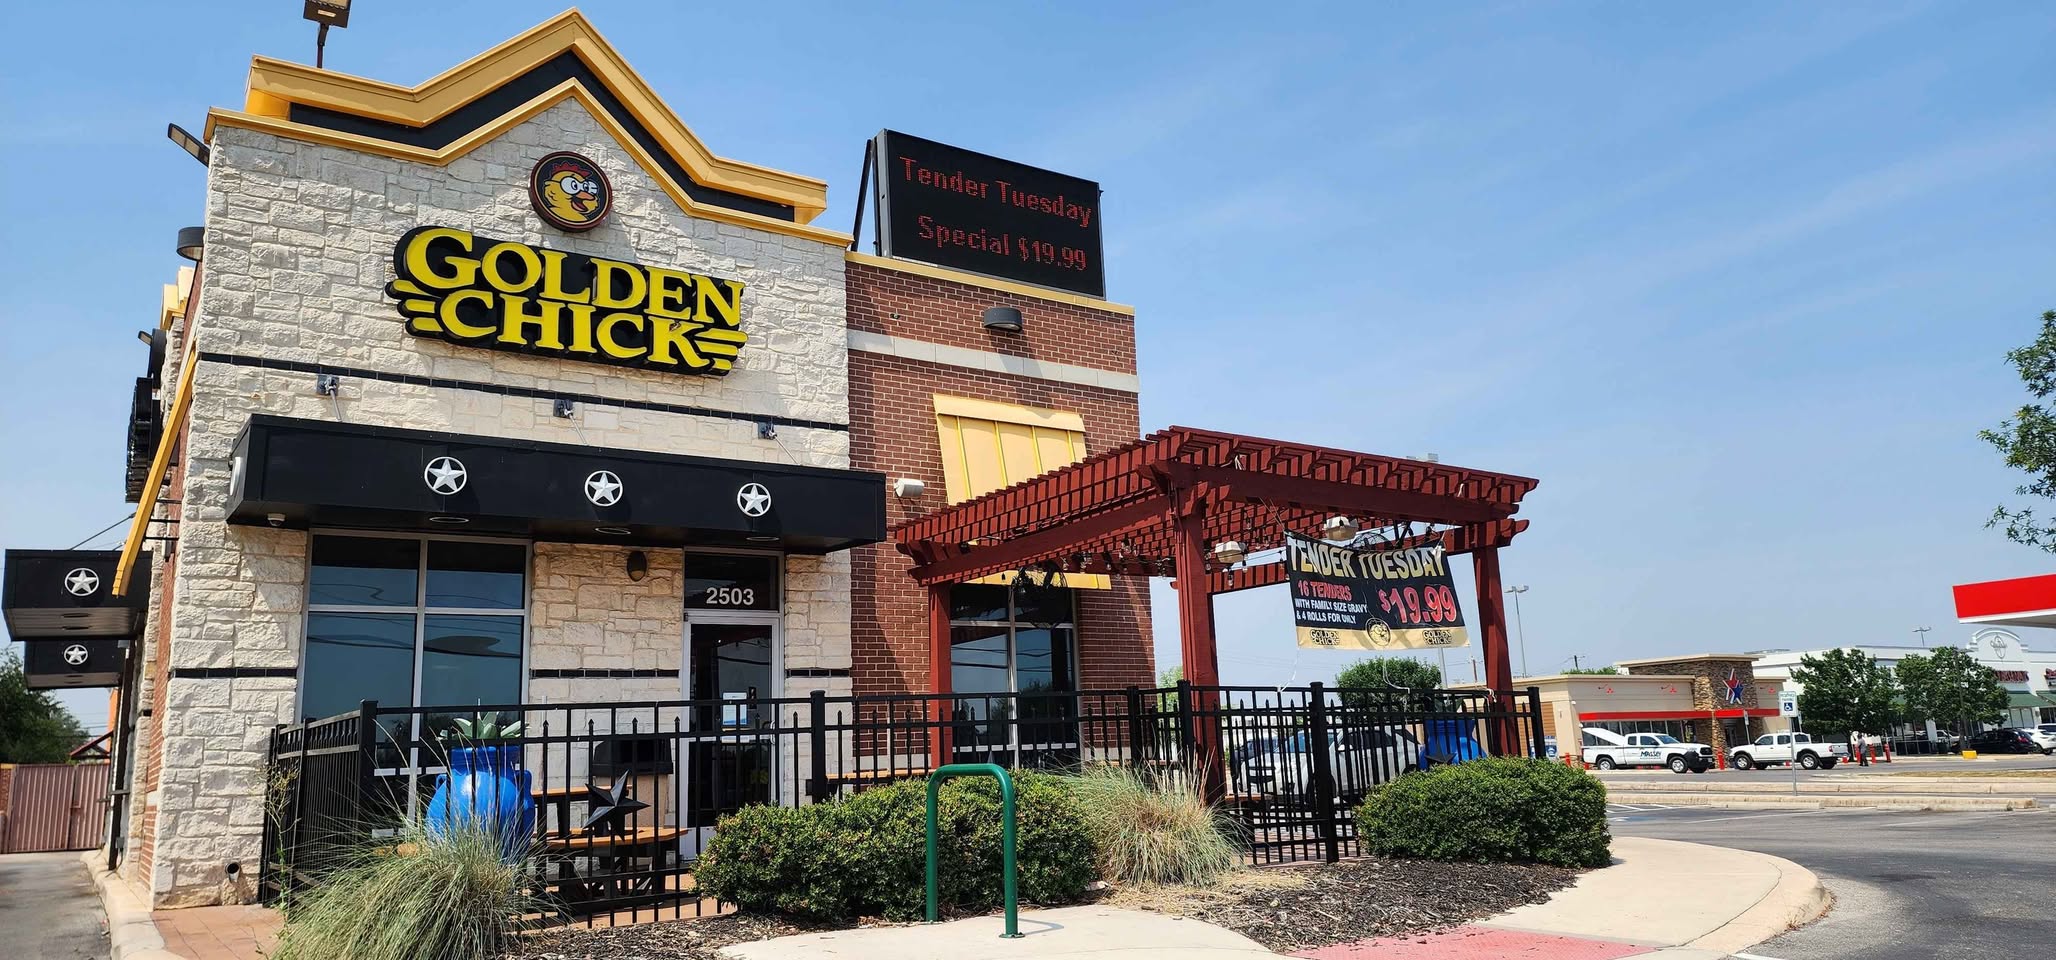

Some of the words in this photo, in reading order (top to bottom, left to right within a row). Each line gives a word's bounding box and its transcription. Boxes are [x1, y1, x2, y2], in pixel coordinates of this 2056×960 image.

[900, 156, 989, 199] Tender
[995, 180, 1092, 228] Tuesday
[918, 215, 1009, 256] Special
[1018, 235, 1087, 271] $19.99
[406, 227, 746, 326] GOLDEN
[440, 290, 710, 369] CHICK
[1287, 536, 1357, 578] TENDER
[1358, 546, 1445, 580] TUESDAY
[706, 587, 754, 605] 2503
[1298, 580, 1310, 597] 16
[1310, 581, 1353, 602] TENDERS
[1294, 598, 1310, 609] WITH
[1311, 600, 1333, 612] FAMILY
[1333, 601, 1348, 613] SIZE
[1348, 603, 1368, 614] GRAVY
[1378, 585, 1457, 624] $19.99
[1296, 610, 1301, 620] &
[1302, 611, 1307, 620] 4
[1307, 612, 1327, 622] ROLLS
[1327, 613, 1341, 623] FOR
[1341, 614, 1357, 624] ONLY
[1310, 629, 1339, 639] GOLDEN
[1313, 637, 1338, 646] CHICK
[1423, 629, 1451, 639] GOLDEN
[1427, 637, 1451, 645] CHICK
